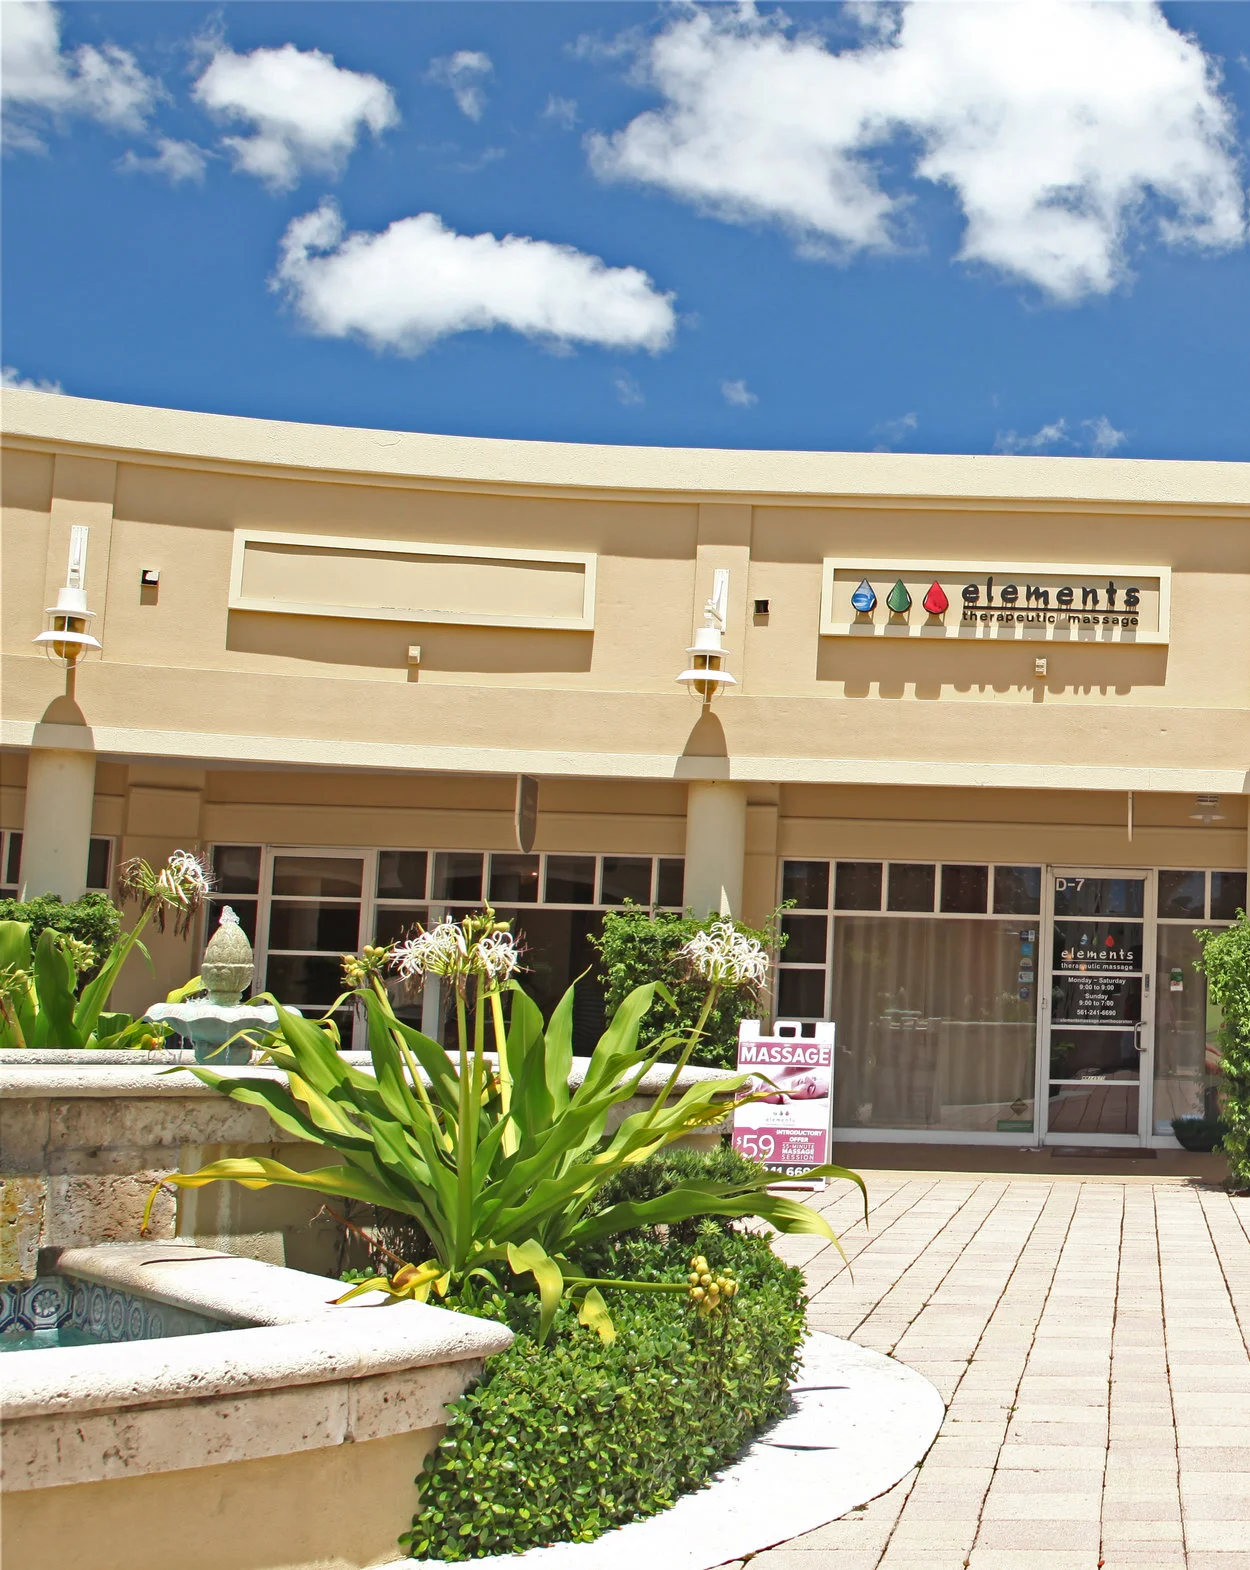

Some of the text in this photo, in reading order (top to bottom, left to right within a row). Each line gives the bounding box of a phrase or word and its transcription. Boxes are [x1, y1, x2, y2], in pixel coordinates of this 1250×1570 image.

[962, 576, 1141, 607] elements
[962, 610, 1140, 627] therapeutic massage
[1056, 878, 1085, 891] D-7
[1061, 947, 1134, 960] elements
[1102, 963, 1133, 971] massage
[1068, 976, 1092, 984] Monday
[1098, 977, 1126, 985] Saturday
[1085, 993, 1108, 1001] Sunday
[740, 1046, 830, 1064] MASSAGE
[776, 1129, 823, 1137] INTRODUCTORY
[736, 1134, 775, 1160] $59
